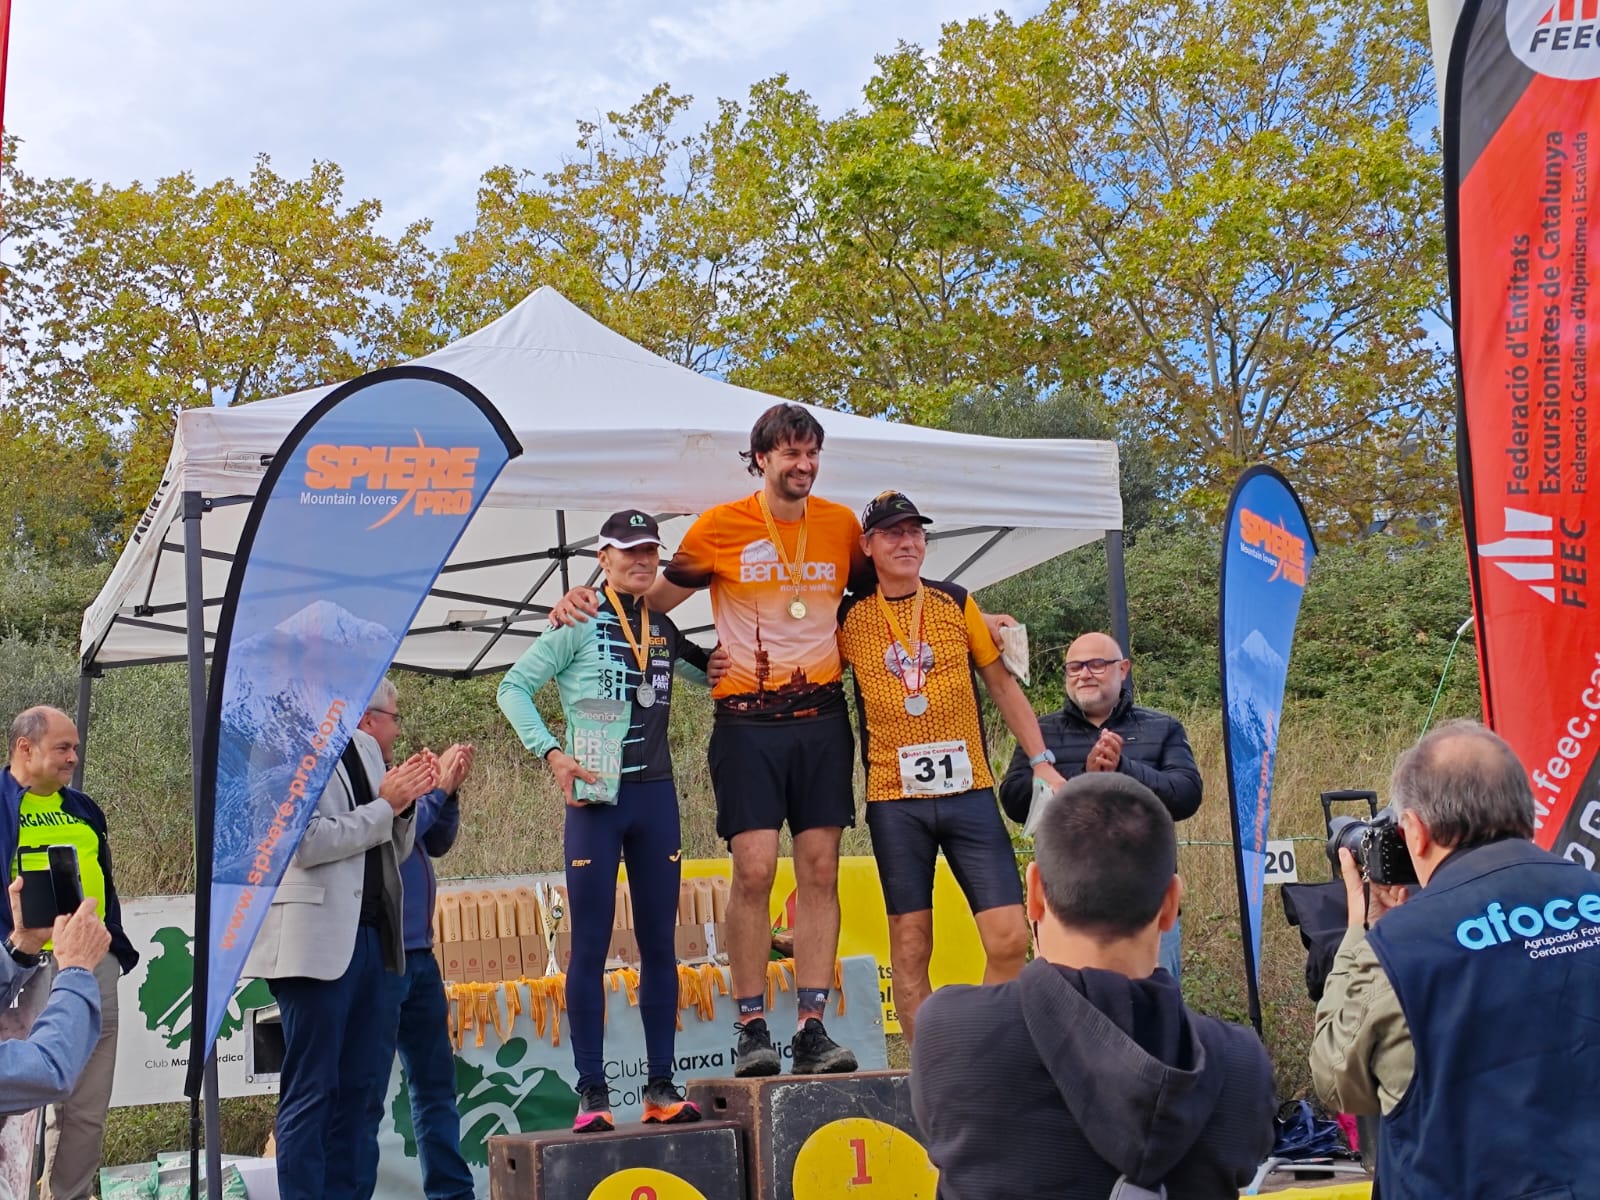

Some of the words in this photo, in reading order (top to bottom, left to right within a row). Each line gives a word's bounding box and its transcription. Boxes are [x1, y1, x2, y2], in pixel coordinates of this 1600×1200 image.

[1537, 131, 1568, 260] Catalunya
[1571, 131, 1588, 203] Escalada
[1505, 234, 1530, 358] d'Entitats
[1537, 266, 1561, 298] de
[1571, 216, 1590, 320] d'Alpinisme
[1571, 324, 1587, 402] Catalana
[1505, 365, 1529, 495] Federació
[1537, 305, 1561, 494] Excursionistes
[304, 444, 480, 490] SPHERE
[413, 490, 472, 516] PRO
[1571, 409, 1587, 494] Federació
[300, 492, 356, 505] Mountain
[359, 493, 398, 506] lovers
[1239, 508, 1305, 568] SPHERE
[1559, 517, 1587, 609] FEEC
[915, 754, 953, 782] 31
[20, 812, 82, 827] RGANITZ
[220, 698, 346, 950] www.sphere-pro.com
[1264, 851, 1294, 875] 20
[1524, 930, 1578, 949] Agrupació
[886, 1010, 899, 1021] Es
[145, 1059, 168, 1069] Club
[216, 1053, 244, 1063] rdica
[604, 1058, 649, 1080] Club
[850, 1139, 872, 1185] 1
